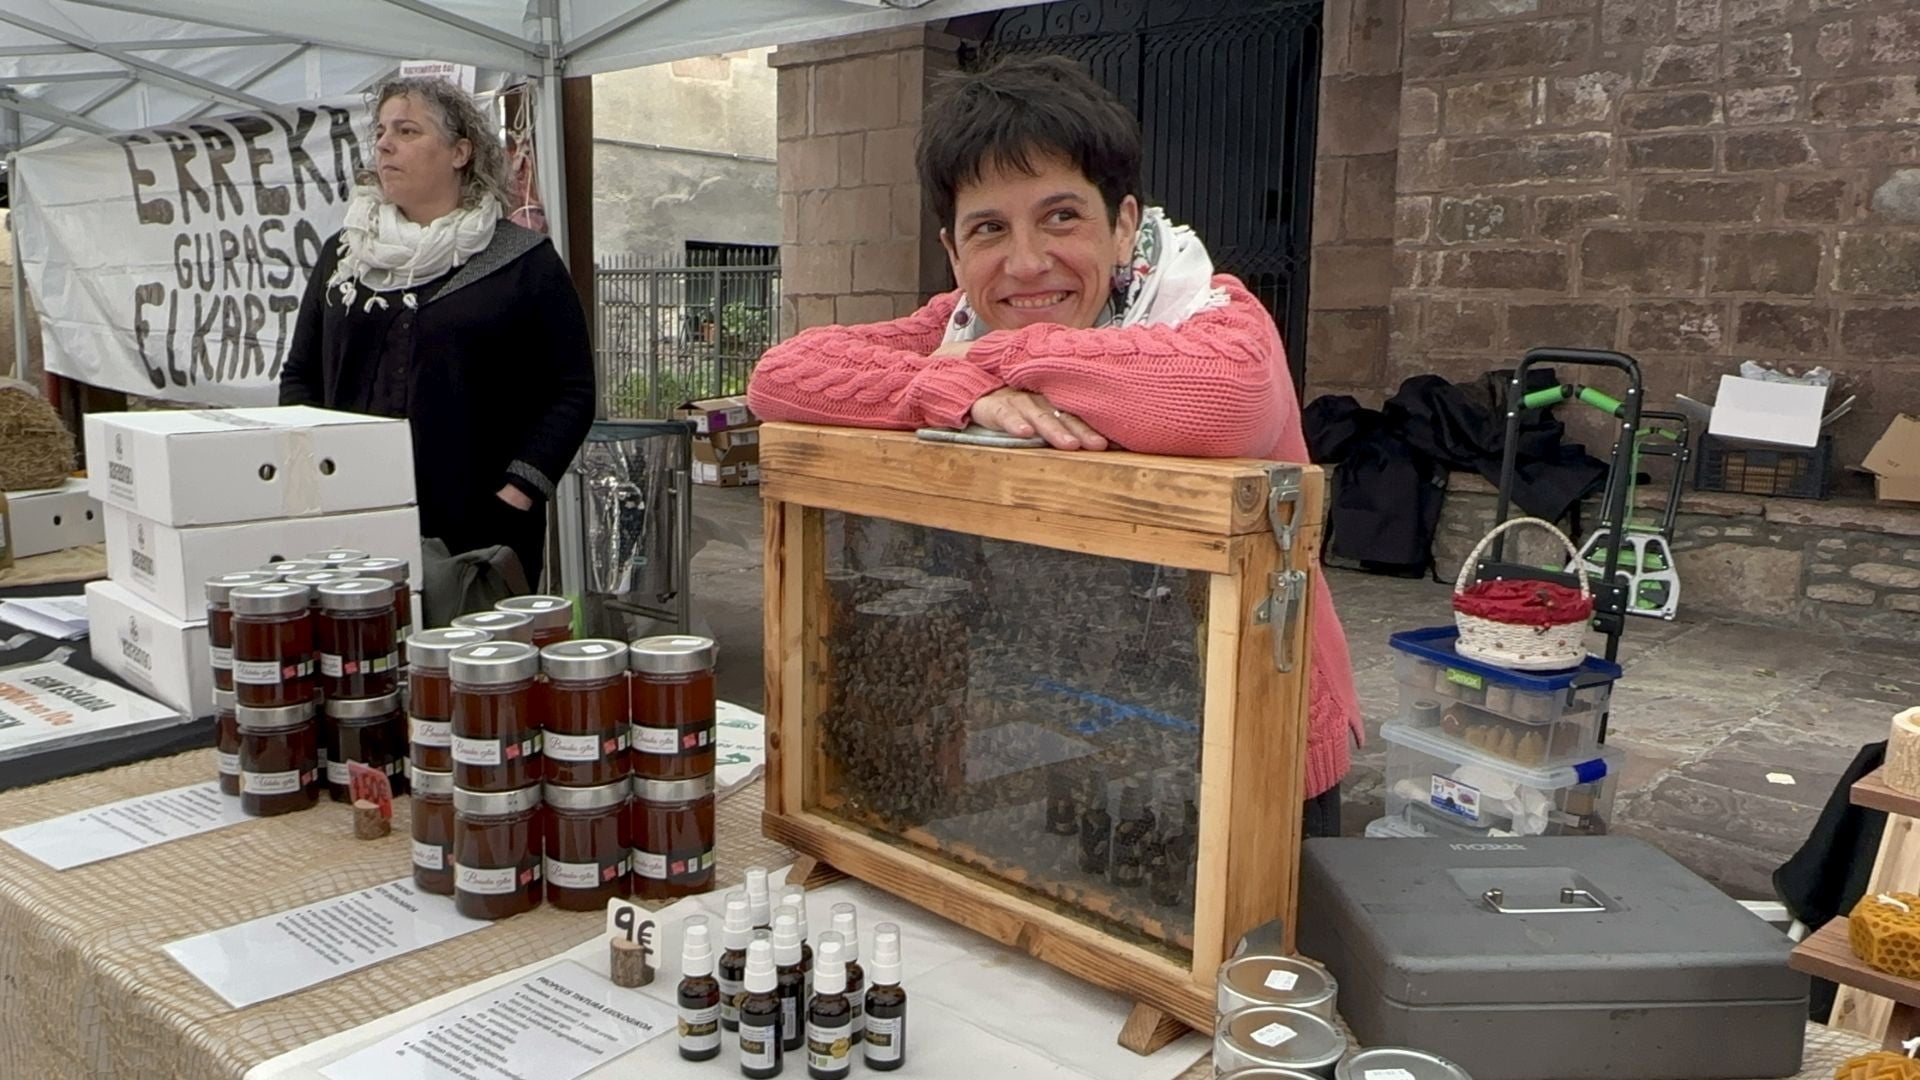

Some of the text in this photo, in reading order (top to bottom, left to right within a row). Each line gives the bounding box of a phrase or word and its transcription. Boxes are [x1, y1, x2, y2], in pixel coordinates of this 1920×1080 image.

[174, 219, 323, 290] GURASO
[614, 906, 656, 955] 9€
[536, 976, 574, 997] PROPOLIS
[571, 992, 605, 1011] TINTURA
[602, 1006, 653, 1032] EKOLOGIKOA
